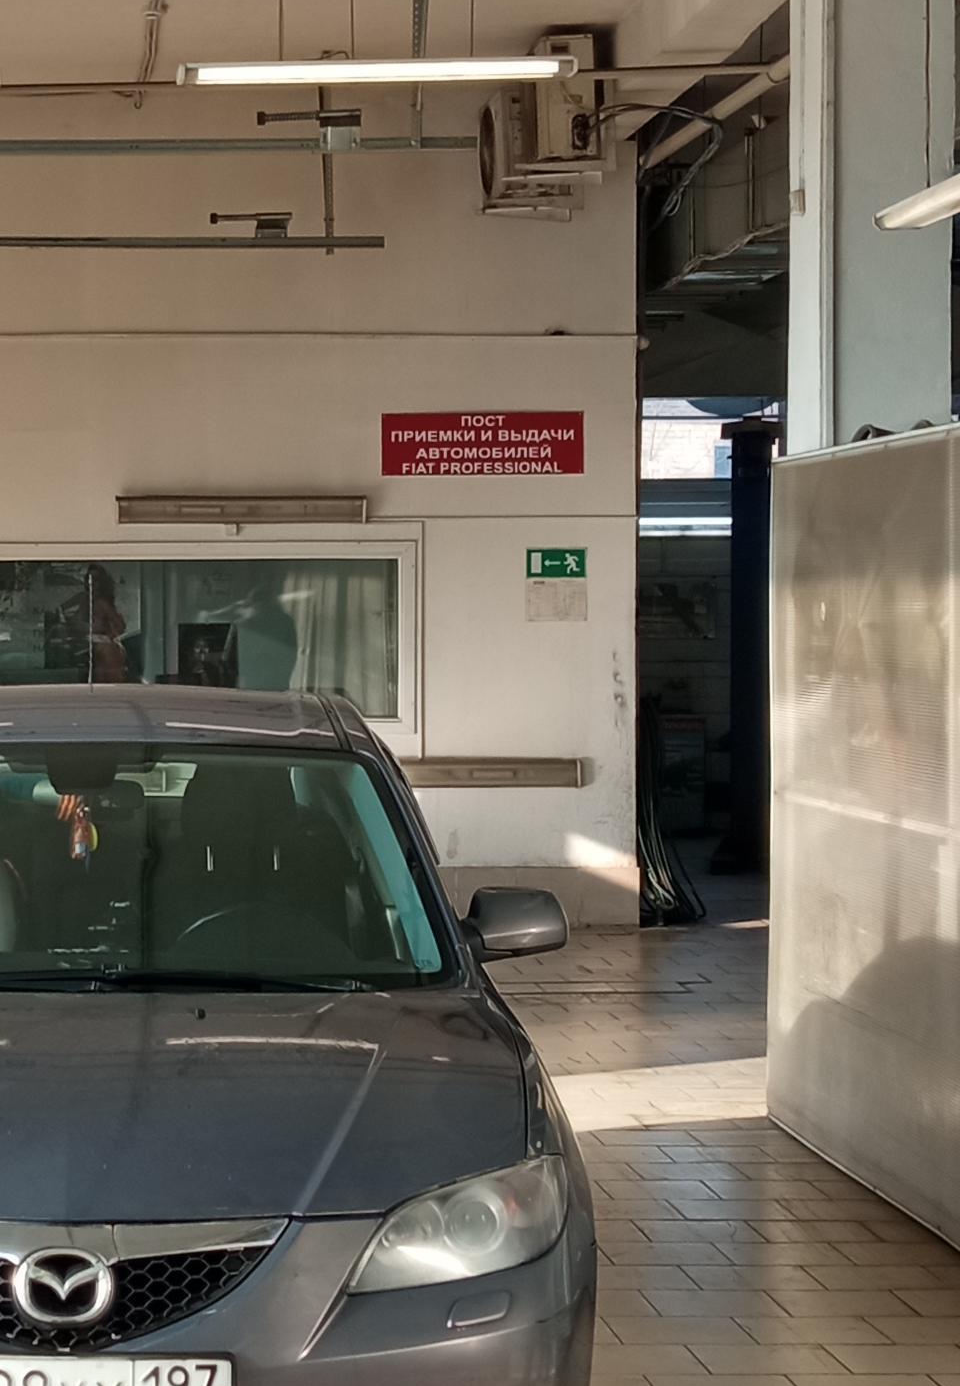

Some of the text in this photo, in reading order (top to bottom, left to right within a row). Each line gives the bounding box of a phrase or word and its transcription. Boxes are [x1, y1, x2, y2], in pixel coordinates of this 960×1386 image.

[461, 415, 506, 427] ПОСТ
[391, 429, 575, 443] ПРИЕМКИ И ВЫДАЧИ
[416, 444, 552, 459] АВТОМОБИЛЕЙ
[402, 461, 563, 474] FIAT PROFESSIONAL
